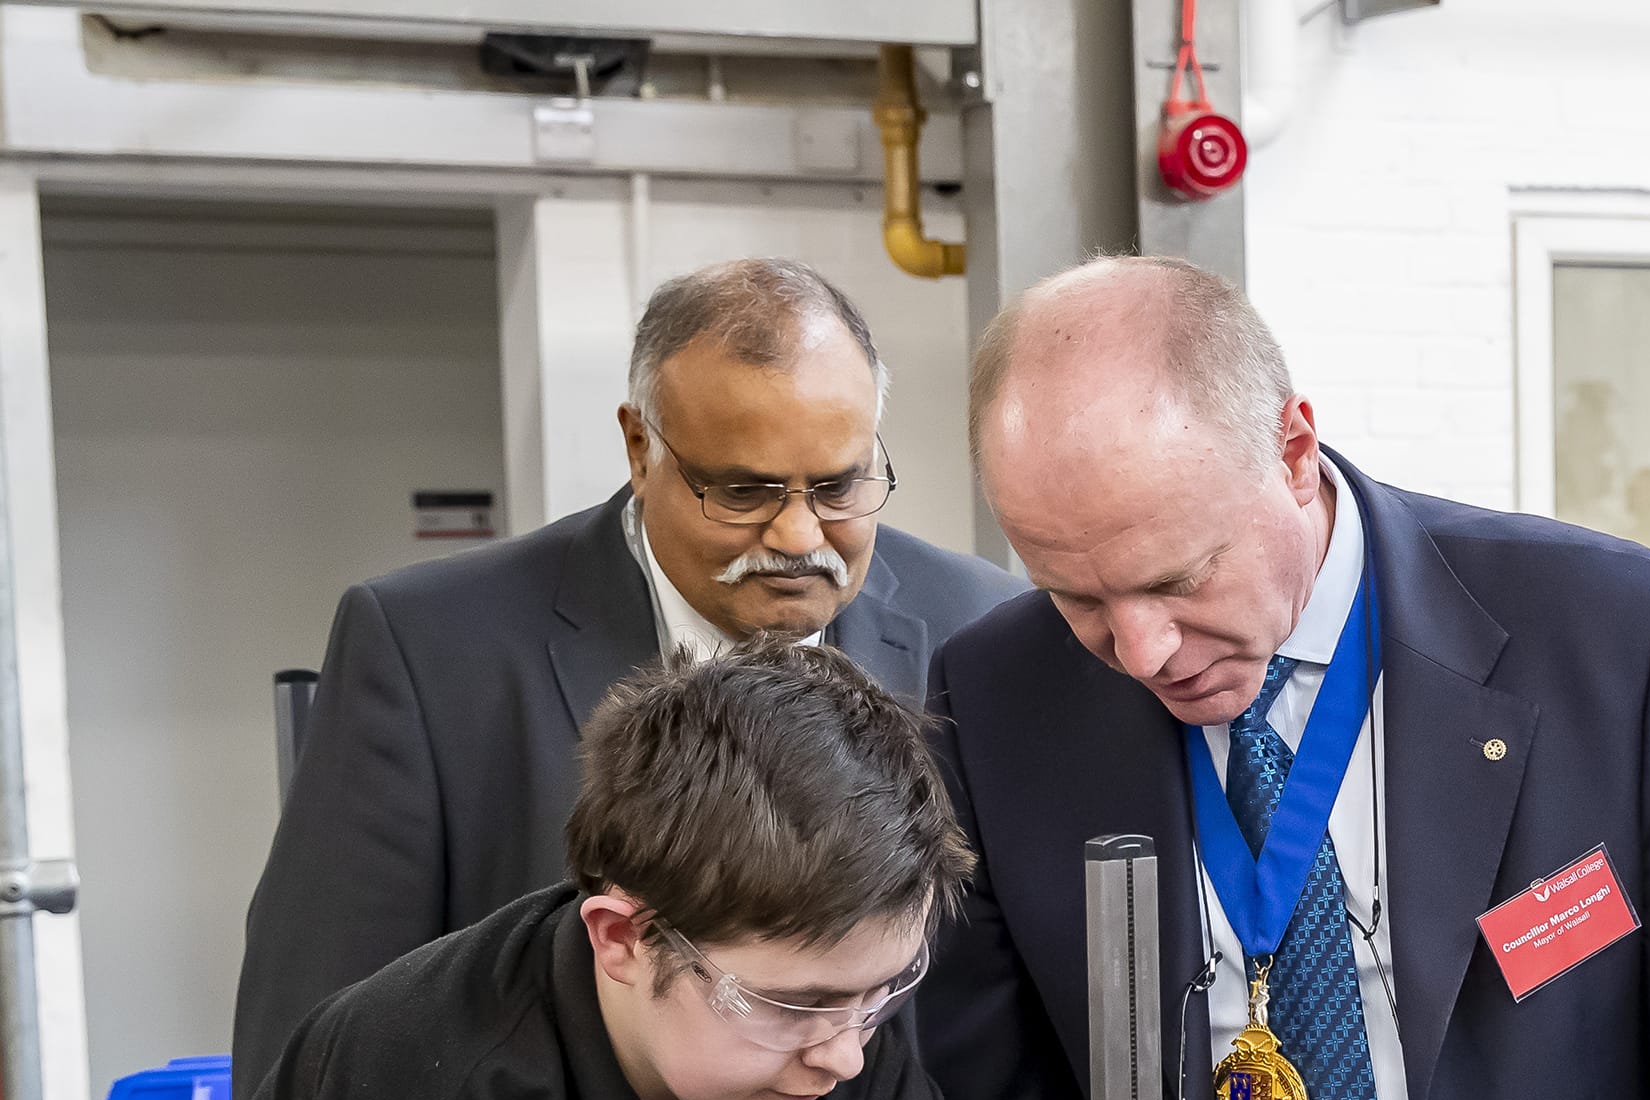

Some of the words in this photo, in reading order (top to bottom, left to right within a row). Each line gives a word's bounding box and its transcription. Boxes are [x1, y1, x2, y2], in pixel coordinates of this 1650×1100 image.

[1549, 871, 1579, 894] Walsall
[1577, 858, 1605, 879] College
[1502, 921, 1549, 953] Councillor
[1549, 905, 1580, 927] Marco
[1579, 884, 1611, 909] Longhi
[1533, 932, 1556, 949] Mayor
[1556, 925, 1565, 936] of
[1564, 910, 1591, 931] Walsall
